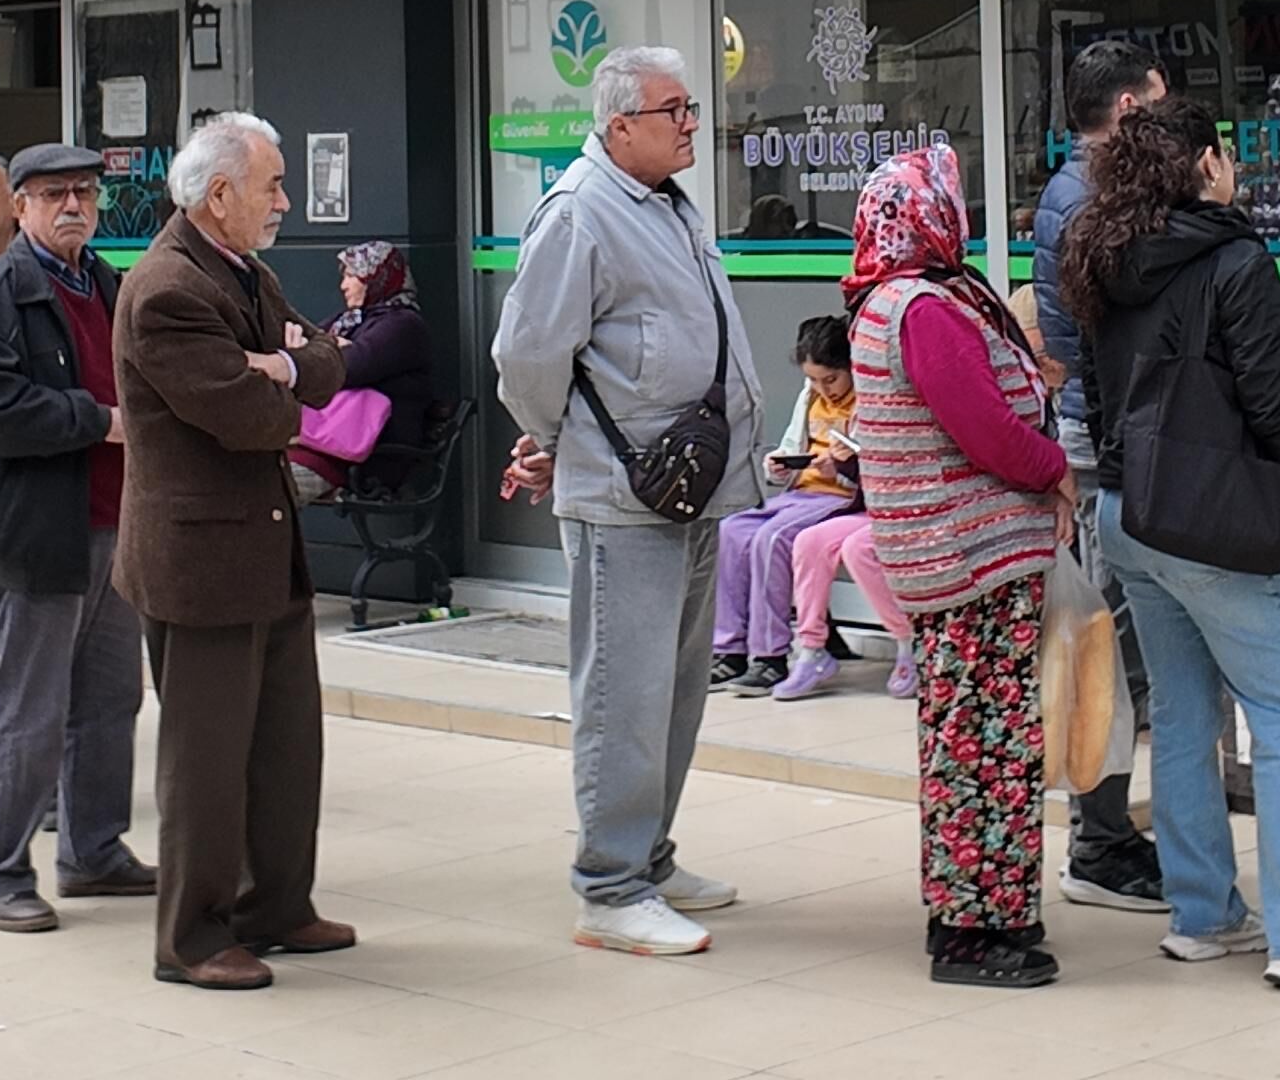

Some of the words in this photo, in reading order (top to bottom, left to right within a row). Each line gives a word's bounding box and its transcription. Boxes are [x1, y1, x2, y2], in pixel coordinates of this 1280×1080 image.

[803, 105, 833, 125] T.C.
[835, 103, 885, 124] AYDIN
[800, 170, 873, 192] BELEDİY
